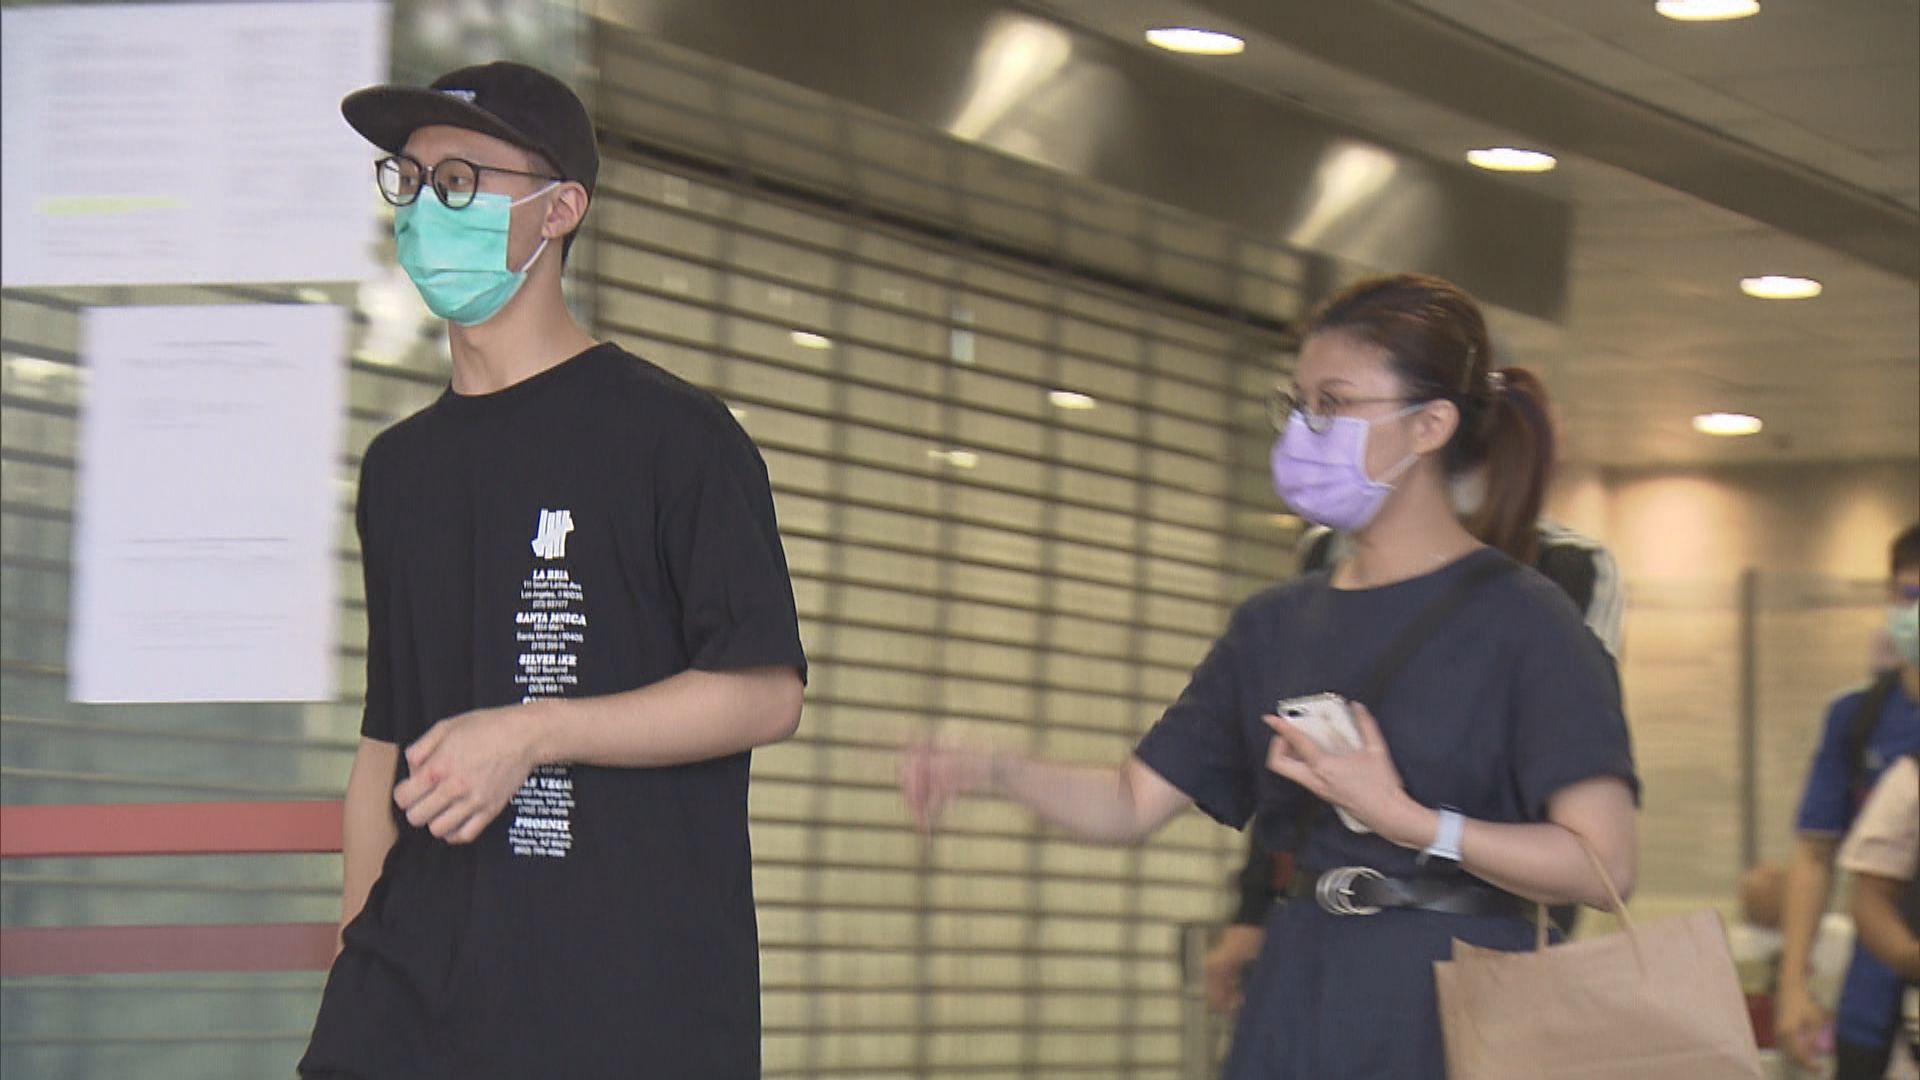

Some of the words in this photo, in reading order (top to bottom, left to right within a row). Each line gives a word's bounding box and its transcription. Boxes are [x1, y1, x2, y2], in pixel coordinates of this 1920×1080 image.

[533, 569, 546, 581] LA
[515, 611, 549, 624] SANTA
[550, 611, 587, 626] MNICA
[519, 653, 556, 666] SILVER
[540, 777, 574, 790] VEGA
[514, 816, 571, 831] PHOENIX
